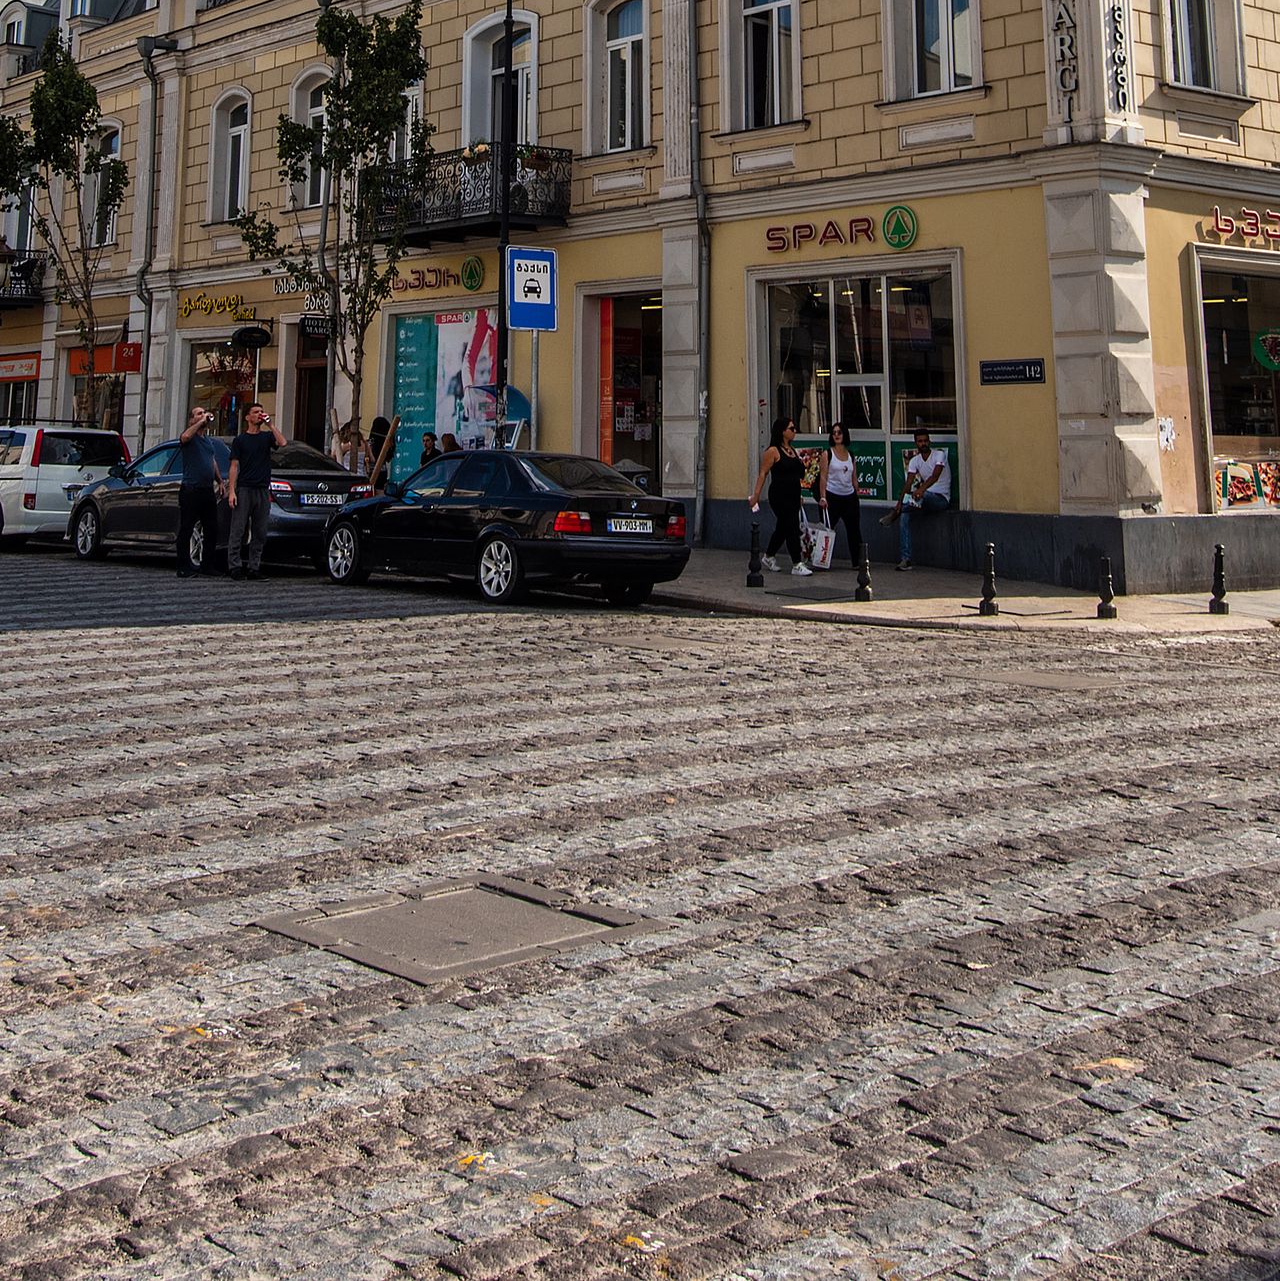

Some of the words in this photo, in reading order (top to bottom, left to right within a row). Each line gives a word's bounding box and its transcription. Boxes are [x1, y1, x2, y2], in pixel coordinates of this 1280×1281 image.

[766, 215, 875, 253] SPAR
[516, 263, 549, 274] ტაქსი
[441, 314, 463, 324] SPAR
[306, 326, 332, 335] MARG
[122, 347, 134, 358] 24
[1025, 365, 1041, 378] 142
